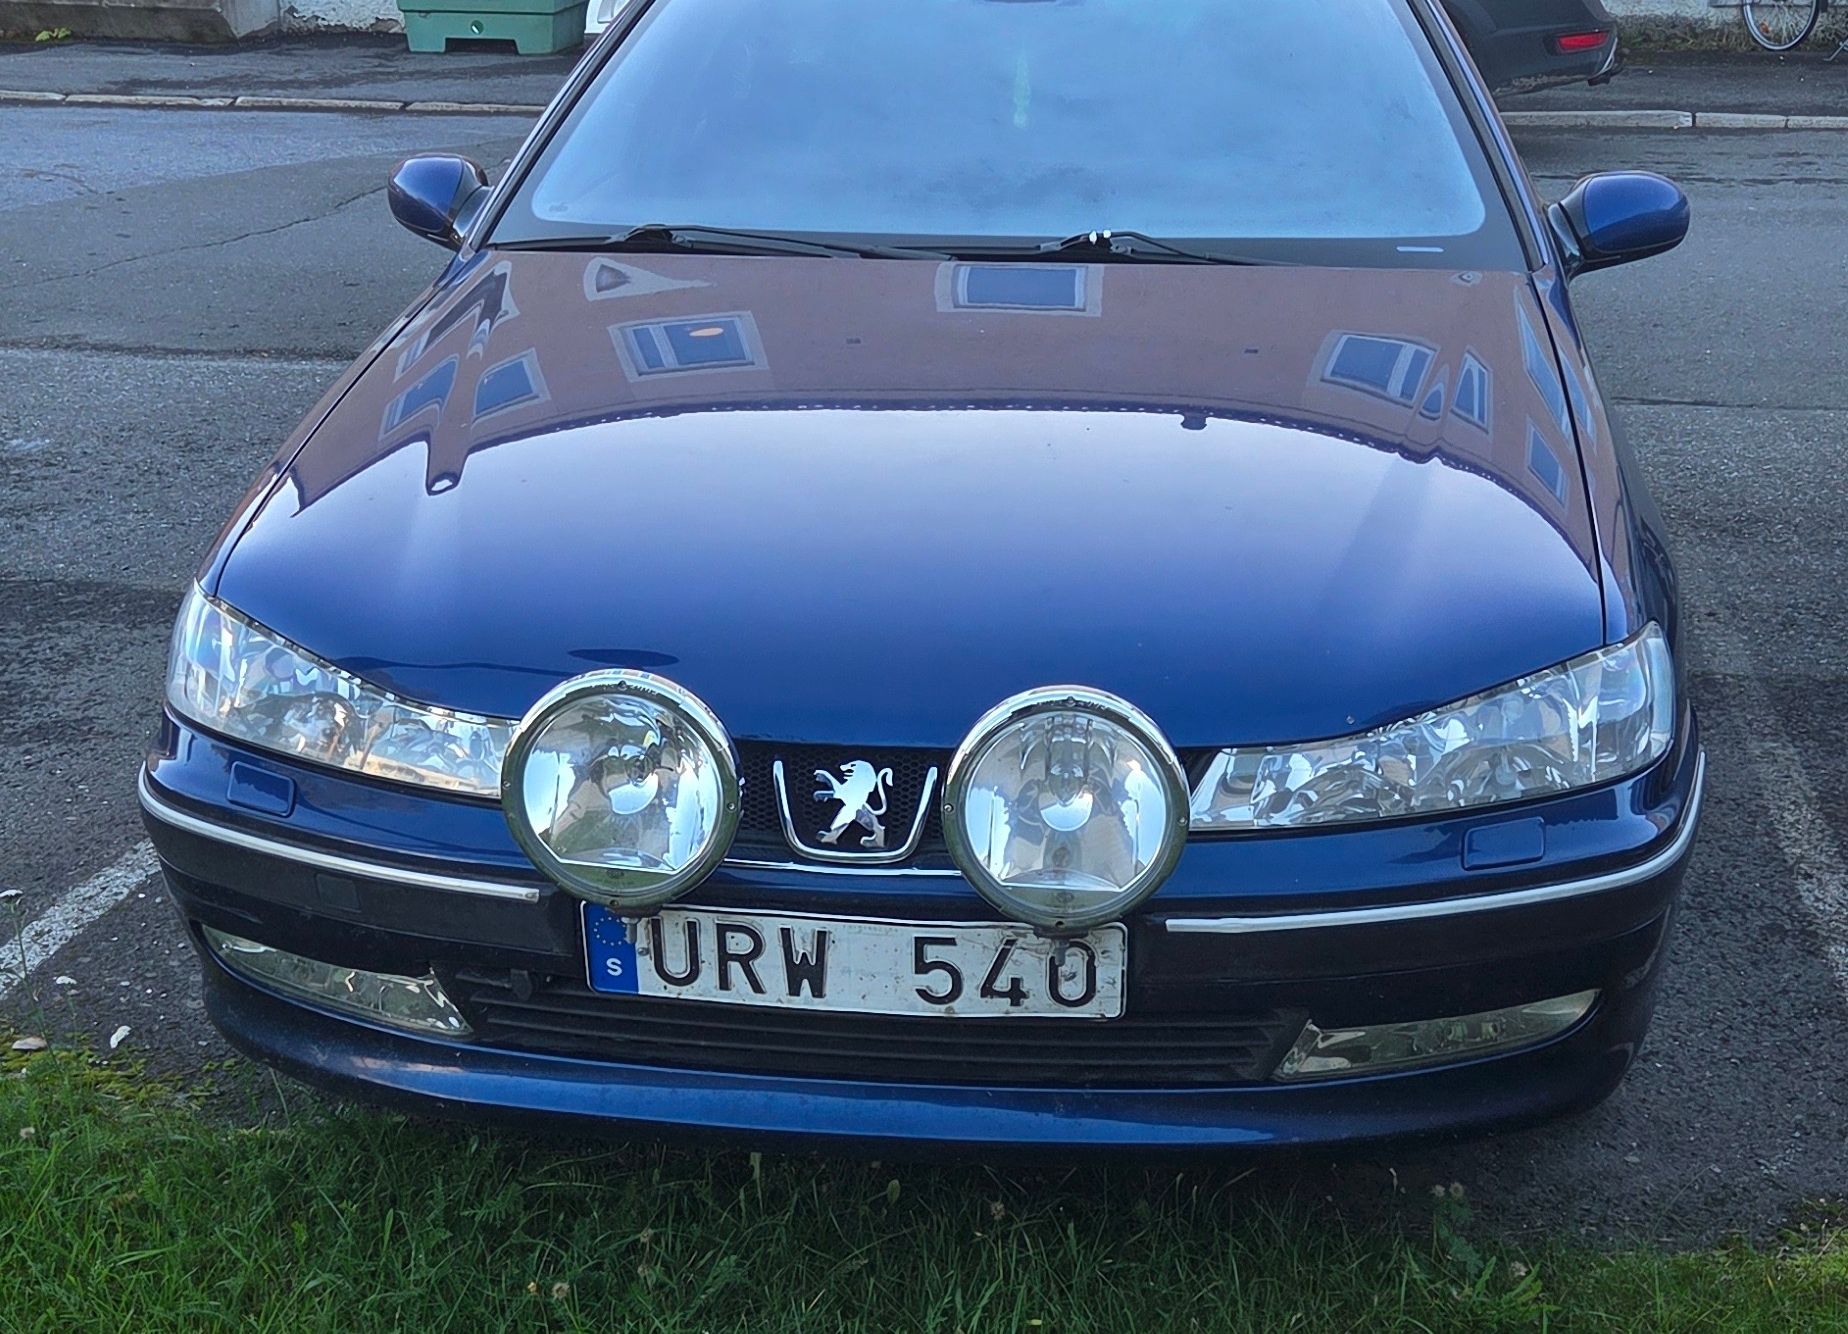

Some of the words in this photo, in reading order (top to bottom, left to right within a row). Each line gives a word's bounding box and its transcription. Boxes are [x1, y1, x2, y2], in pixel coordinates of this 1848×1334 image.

[606, 957, 622, 976] S
[650, 917, 831, 999] URW
[913, 935, 1098, 1008] 540
